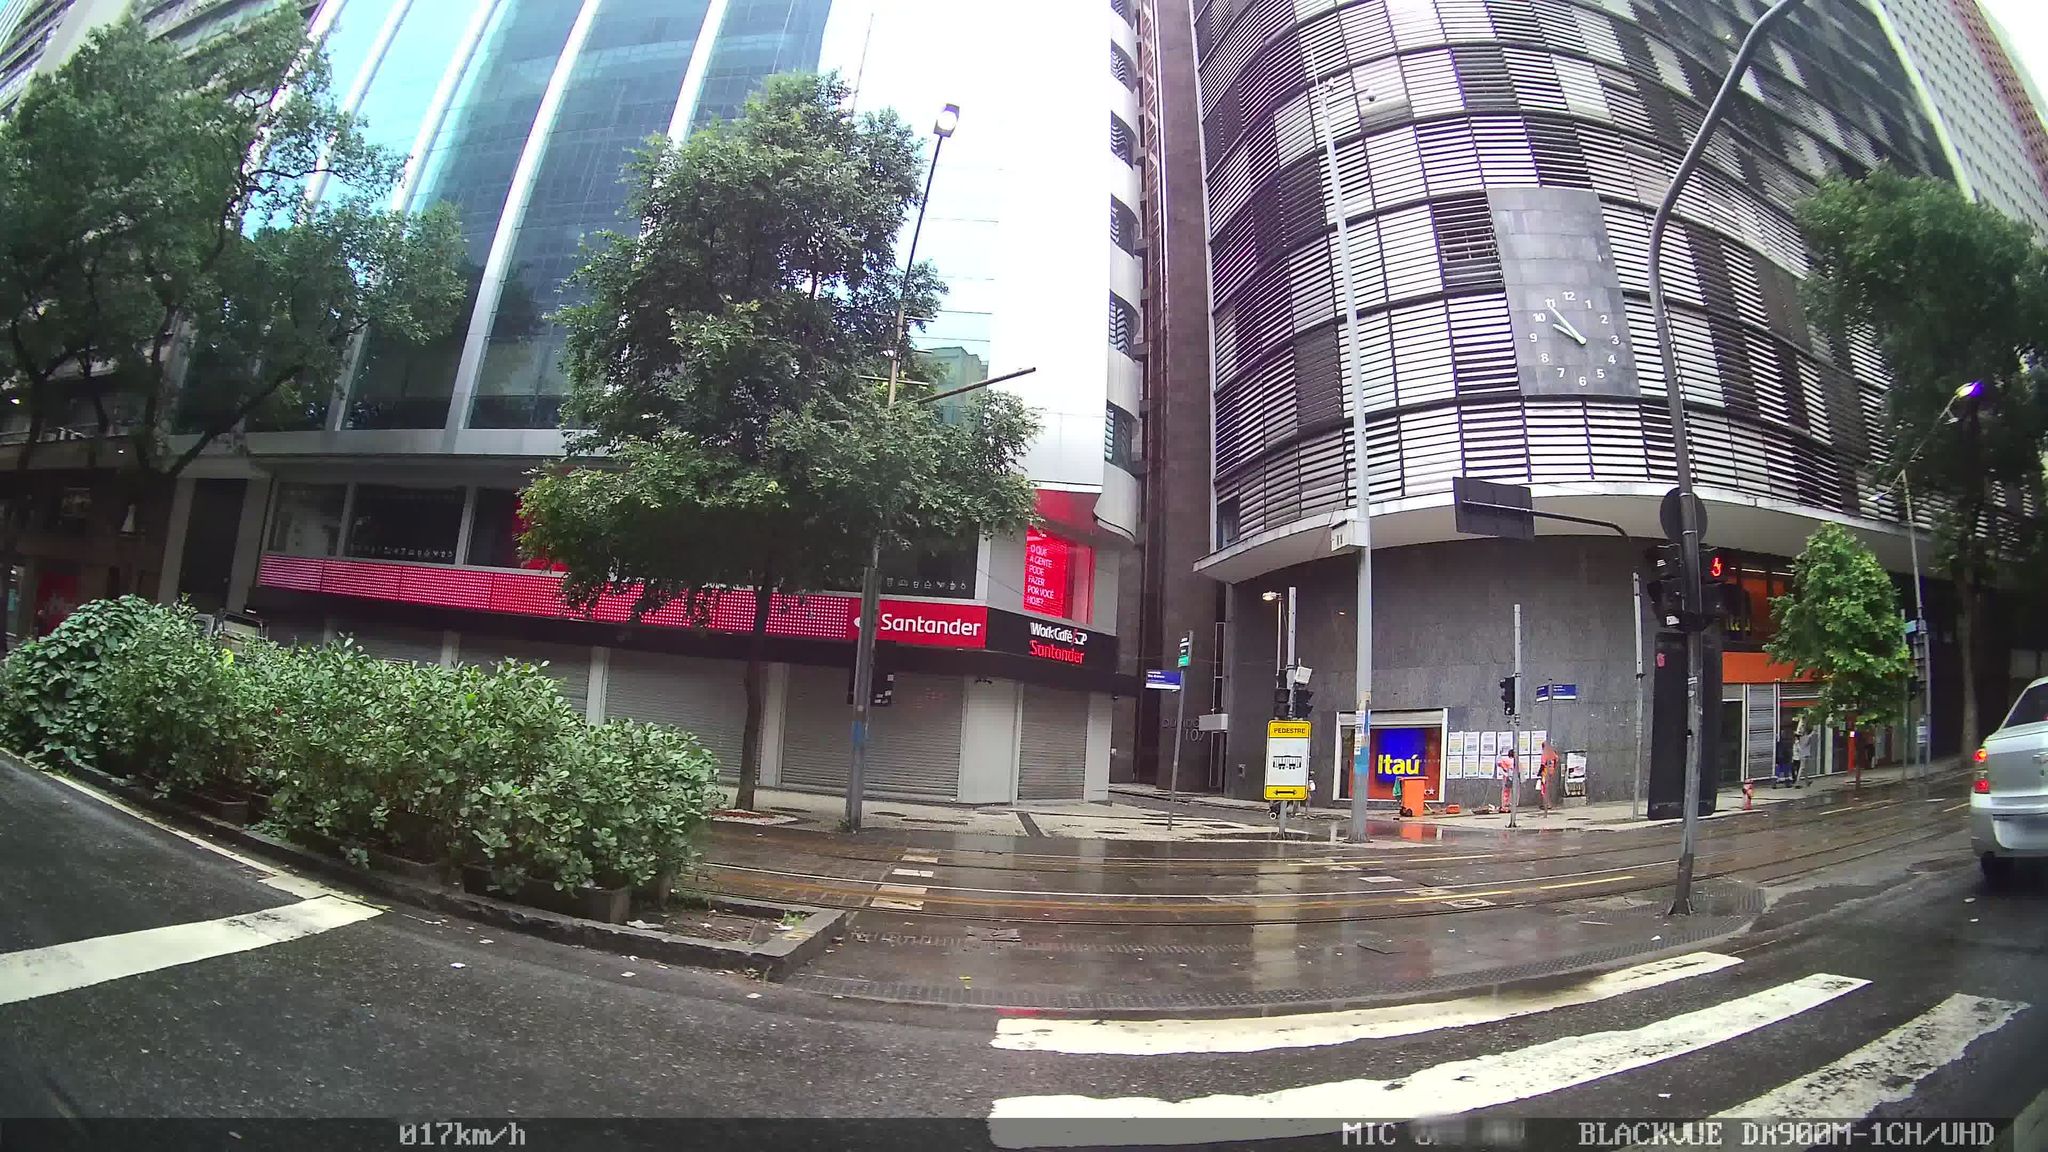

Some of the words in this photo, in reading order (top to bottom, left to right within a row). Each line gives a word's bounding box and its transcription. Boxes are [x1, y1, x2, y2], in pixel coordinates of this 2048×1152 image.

[1562, 291, 1576, 301] 12
[1545, 298, 1556, 308] 11
[1584, 299, 1592, 309] 1
[1533, 312, 1546, 322] 10
[1600, 314, 1609, 324] 2
[1529, 333, 1538, 342] 9
[1611, 335, 1620, 344] 3
[1540, 353, 1549, 363] 8
[1608, 354, 1617, 364] 4
[1557, 367, 1565, 377] 7
[1596, 368, 1605, 378] 5
[1578, 376, 1587, 386] 6
[1030, 544, 1035, 553] O
[1036, 546, 1048, 557] QUE
[1034, 558, 1053, 568] GENTE
[1029, 565, 1044, 576] PODE
[1028, 575, 1045, 587] FAZER
[1027, 585, 1039, 596] POR
[881, 613, 981, 637] Santander
[1030, 640, 1084, 664] Santander
[1377, 754, 1421, 775] Itaú
